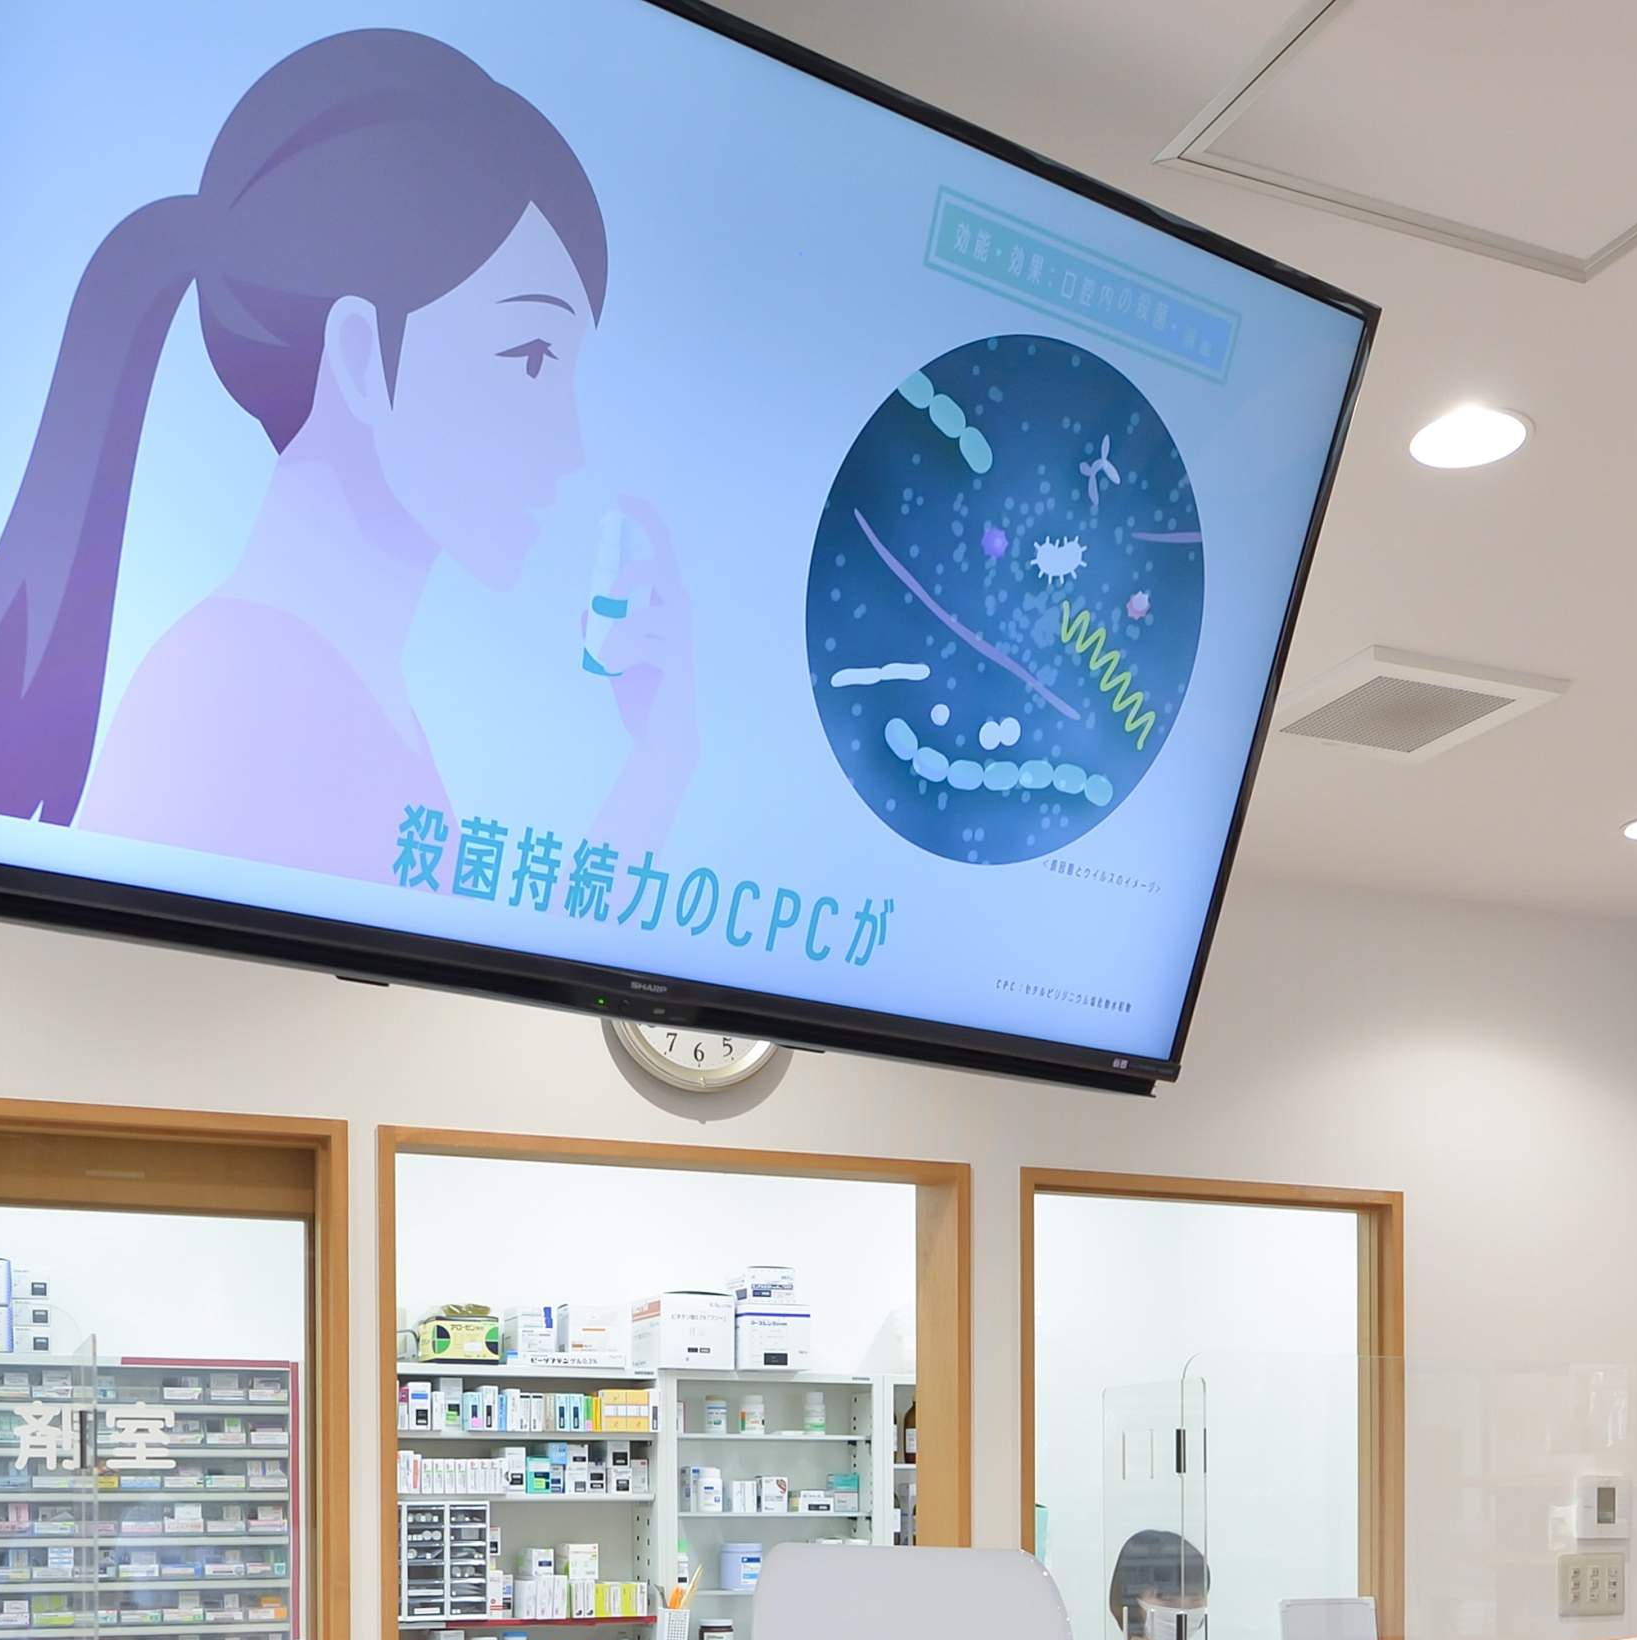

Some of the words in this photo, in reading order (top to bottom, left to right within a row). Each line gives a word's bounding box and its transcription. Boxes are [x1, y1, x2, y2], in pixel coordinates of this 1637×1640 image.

[391, 803, 896, 969] 殺菌持続力のCPCが
[630, 981, 668, 994] SHARP
[666, 1032, 678, 1052] 7
[693, 1042, 705, 1062] 6
[722, 1036, 733, 1057] 5
